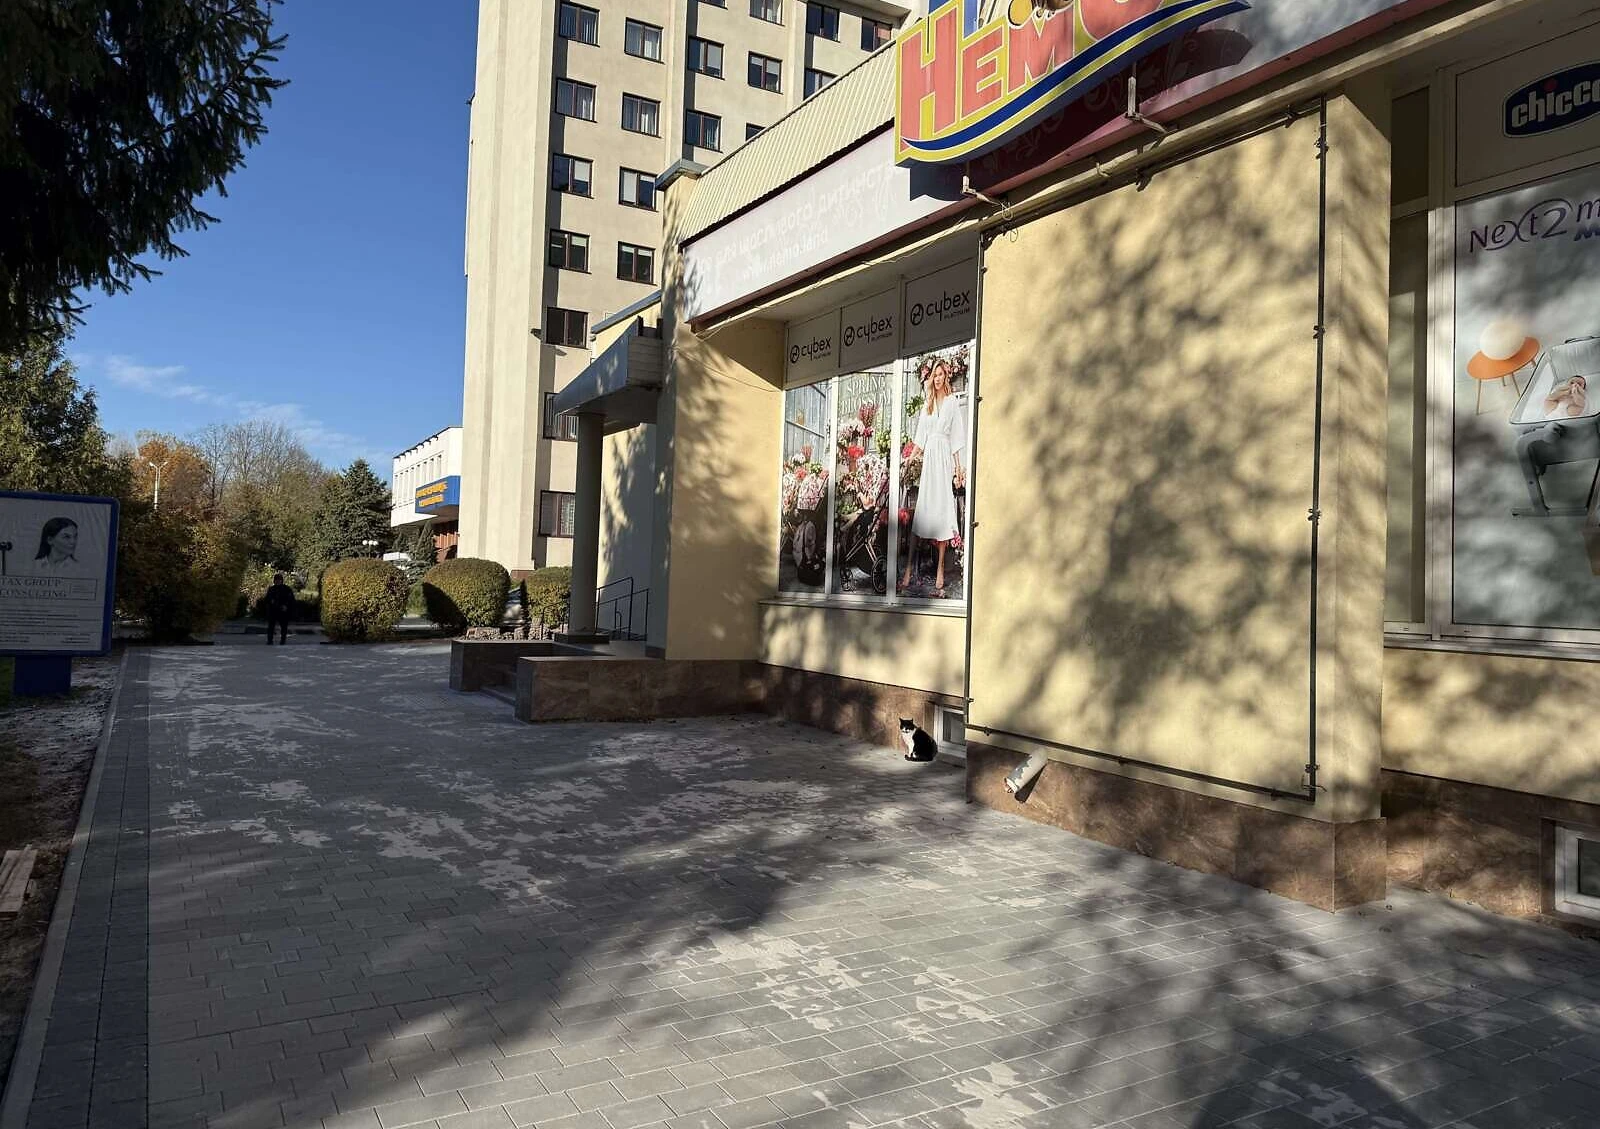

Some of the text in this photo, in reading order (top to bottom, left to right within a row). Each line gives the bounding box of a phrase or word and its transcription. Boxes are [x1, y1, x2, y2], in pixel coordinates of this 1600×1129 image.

[925, 290, 970, 321] cybex
[856, 315, 893, 344] cybex
[801, 336, 832, 361] cybex
[1, 577, 61, 587] TAX GROUP
